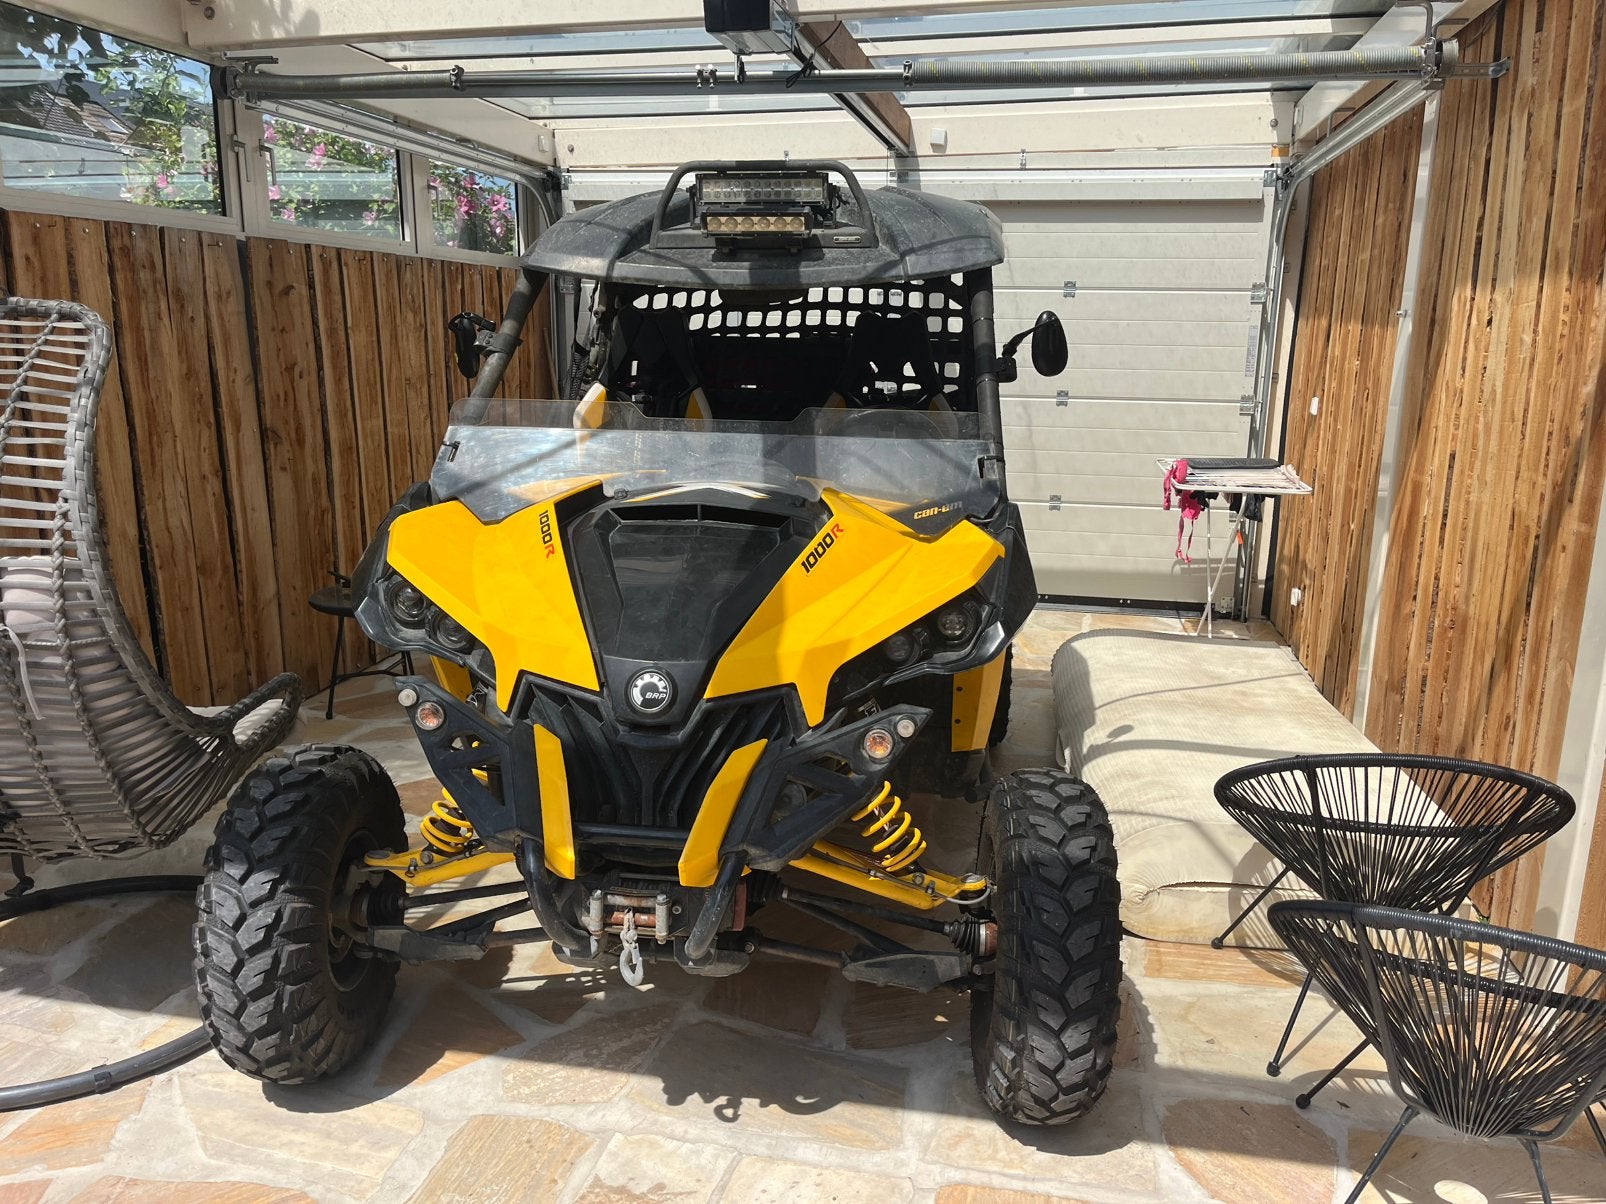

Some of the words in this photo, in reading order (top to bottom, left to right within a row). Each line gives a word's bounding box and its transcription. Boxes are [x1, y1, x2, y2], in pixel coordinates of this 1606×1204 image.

[539, 509, 555, 559] 1000R
[801, 522, 845, 574] 1000R
[645, 691, 667, 700] BRP
